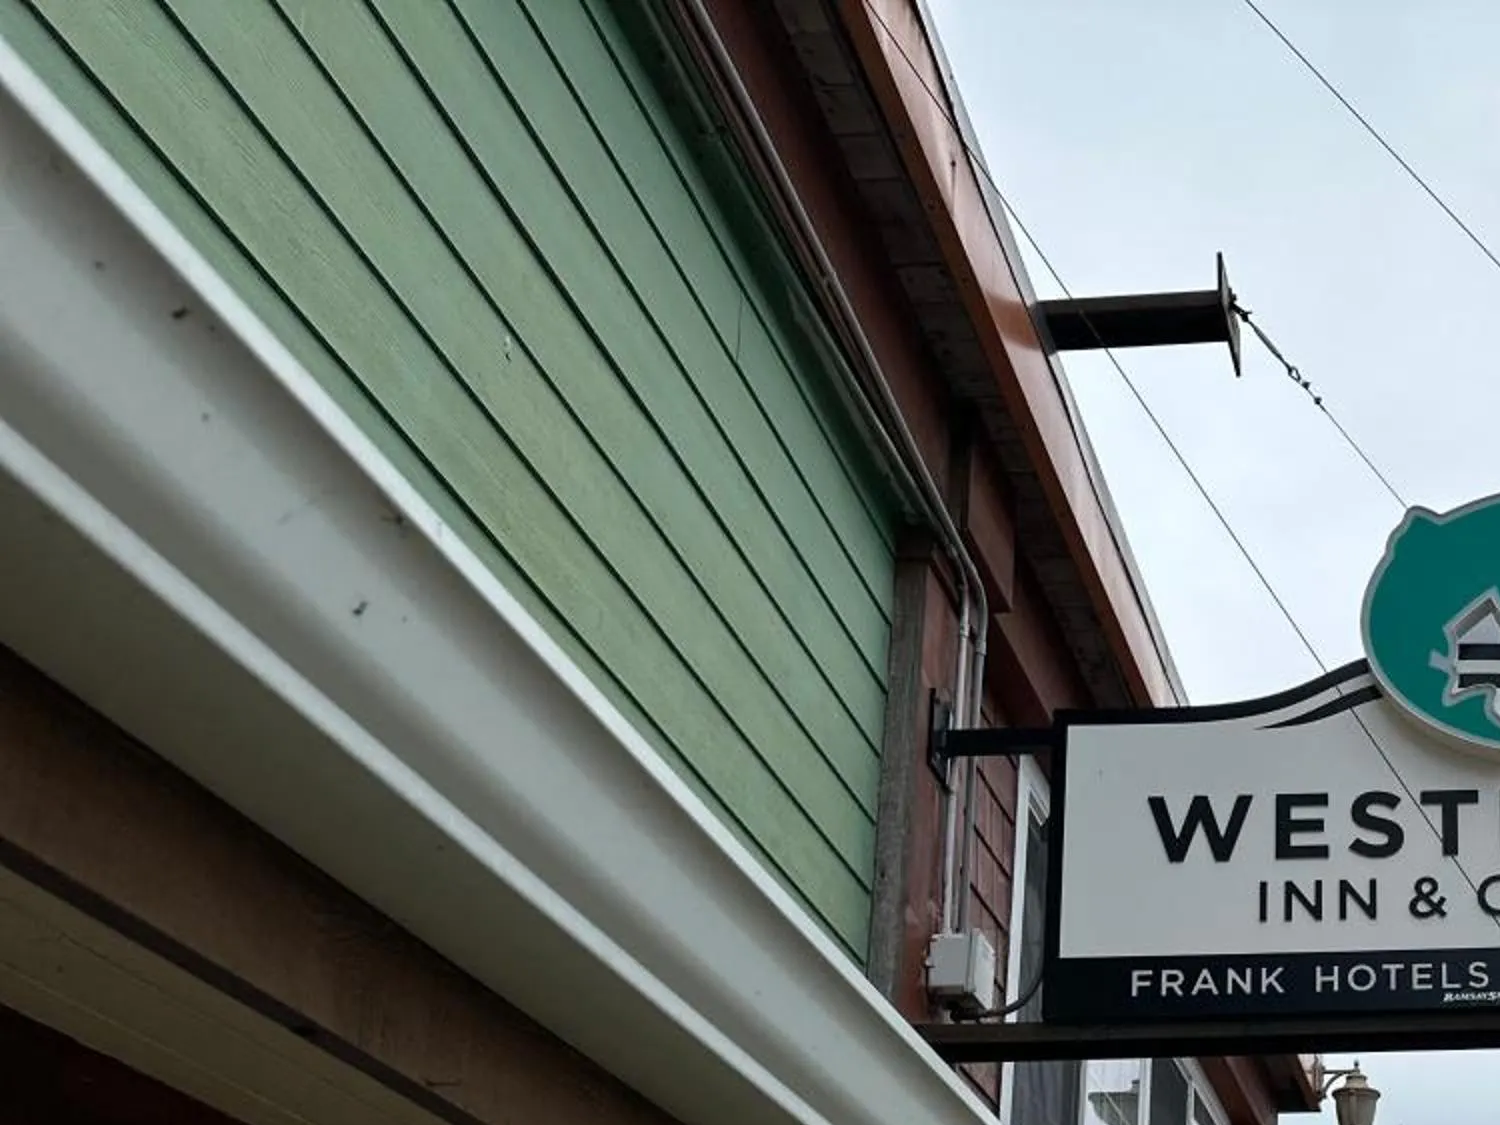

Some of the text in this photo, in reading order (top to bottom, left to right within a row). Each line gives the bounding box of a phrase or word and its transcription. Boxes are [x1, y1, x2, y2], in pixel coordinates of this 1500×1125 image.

[1259, 878, 1377, 923] INN
[1408, 876, 1448, 920] &
[1130, 966, 1286, 998] FRANK
[1314, 961, 1490, 993] HOTELS
